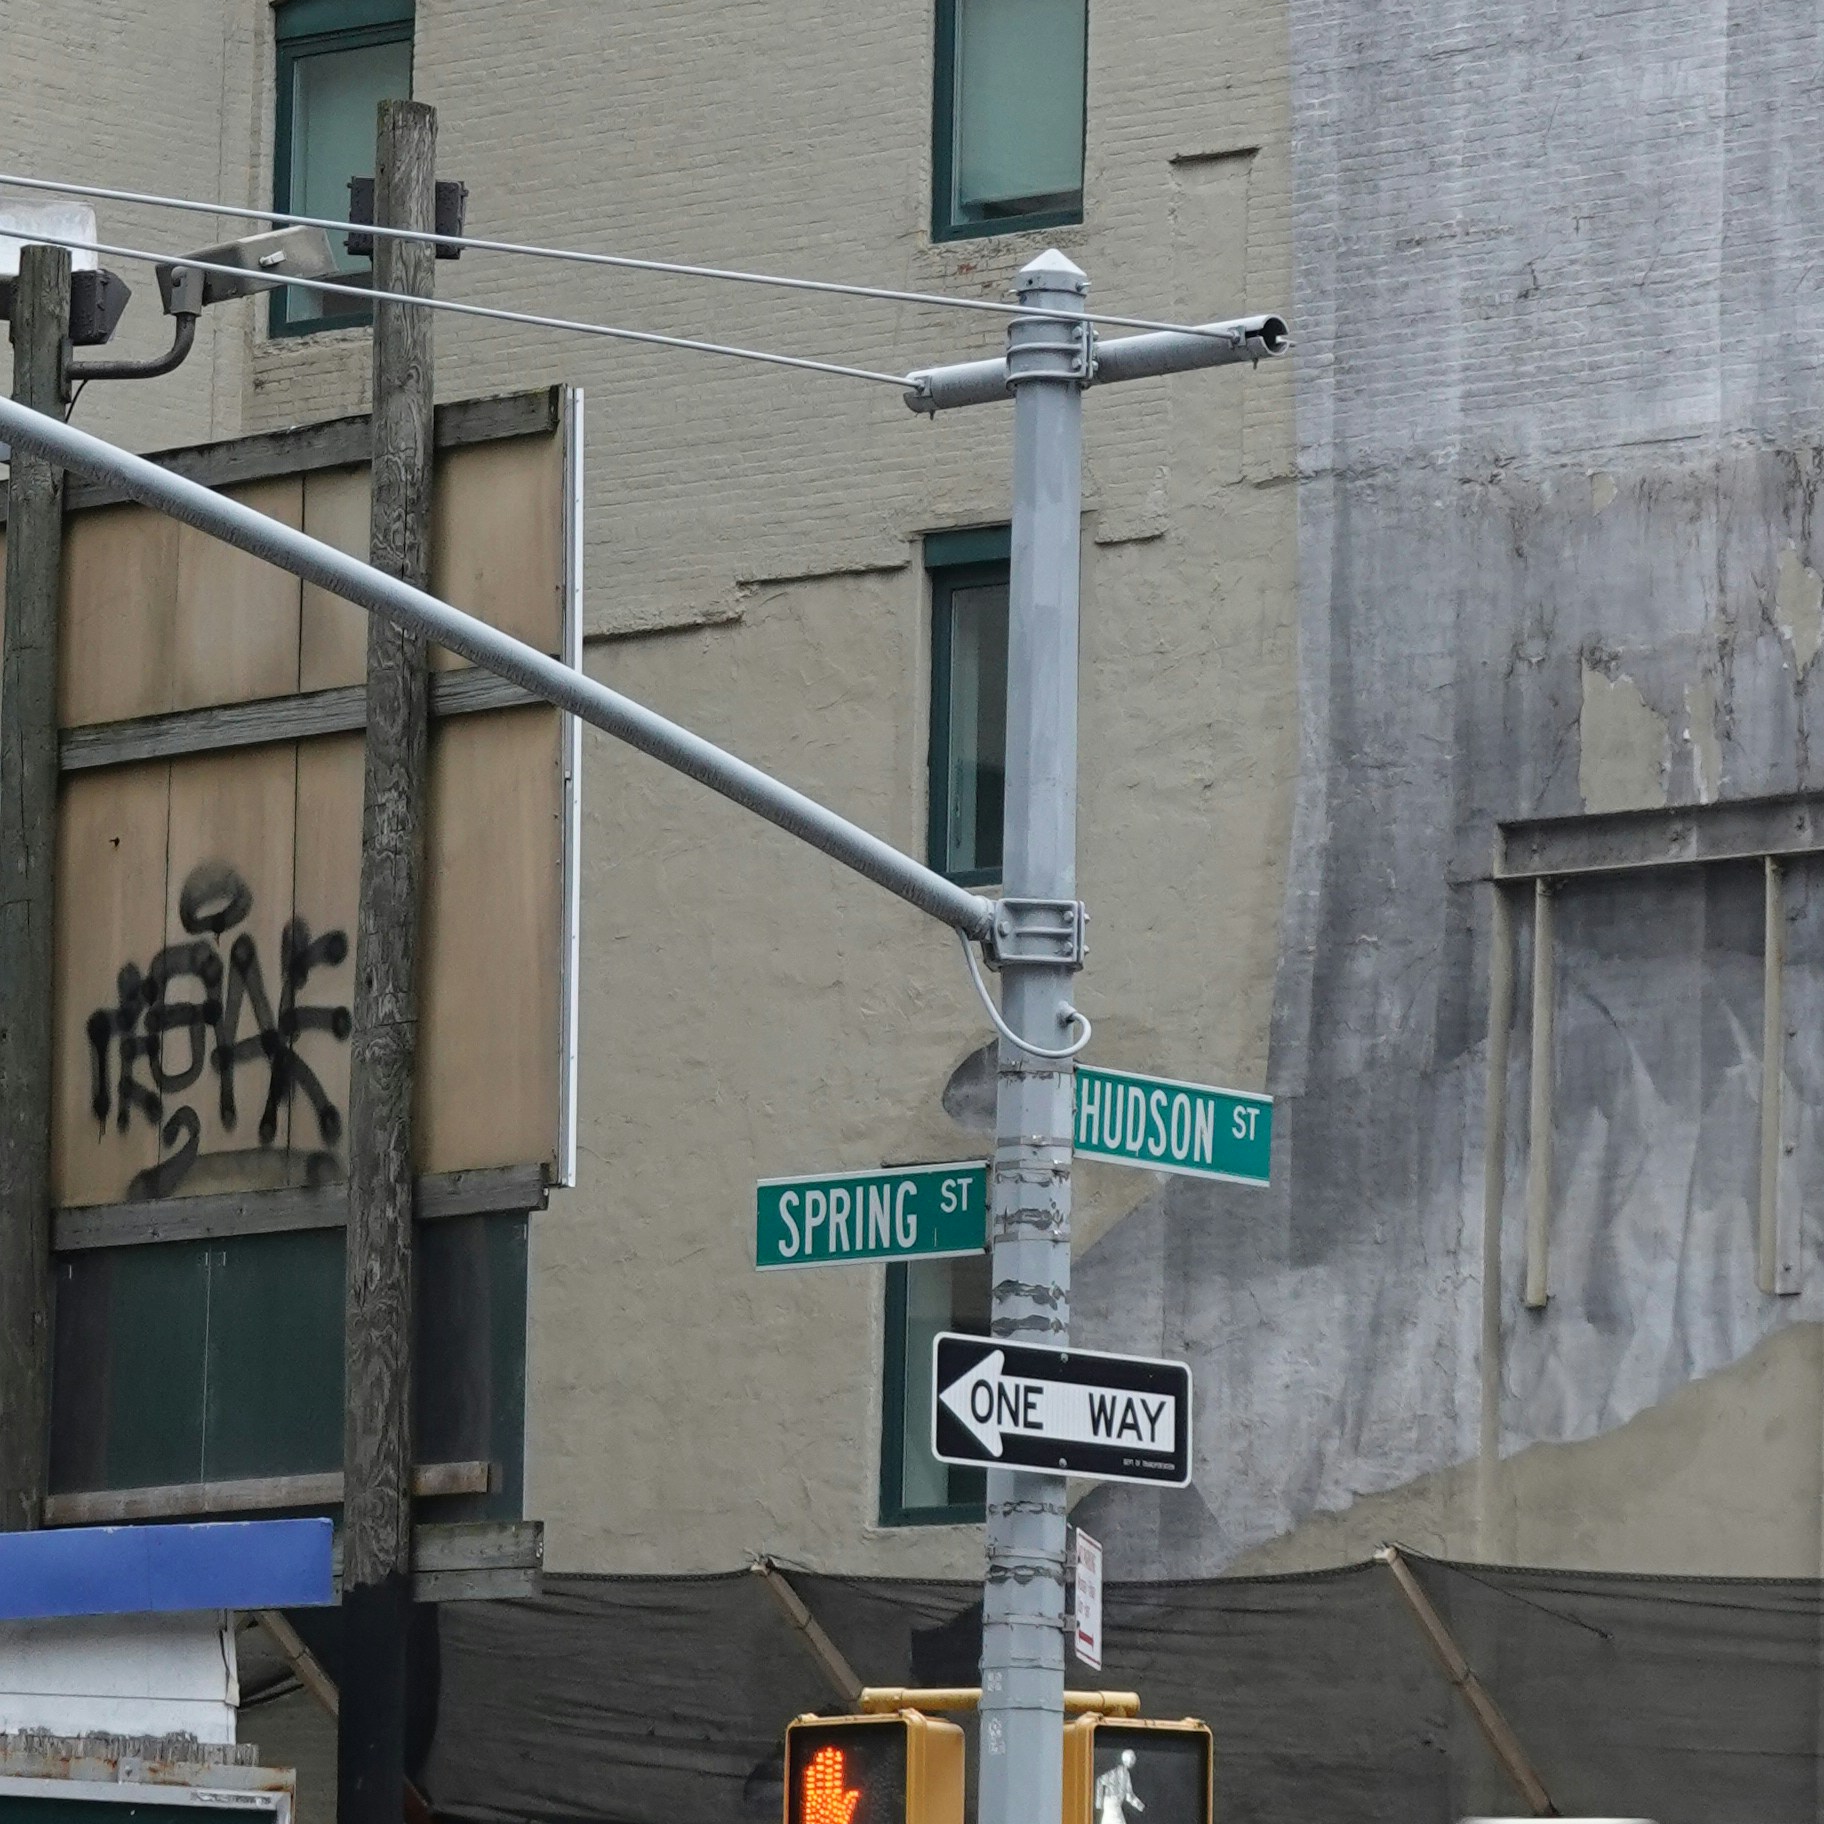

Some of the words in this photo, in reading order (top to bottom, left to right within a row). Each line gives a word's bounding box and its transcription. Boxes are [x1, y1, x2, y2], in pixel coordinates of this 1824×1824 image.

[1080, 1078, 1214, 1164] HUDSON
[1232, 1106, 1261, 1141] ST
[778, 1180, 918, 1258] SPRING
[940, 1177, 973, 1214] ST
[970, 1379, 1045, 1431] ONE
[1088, 1393, 1167, 1443] WAY
